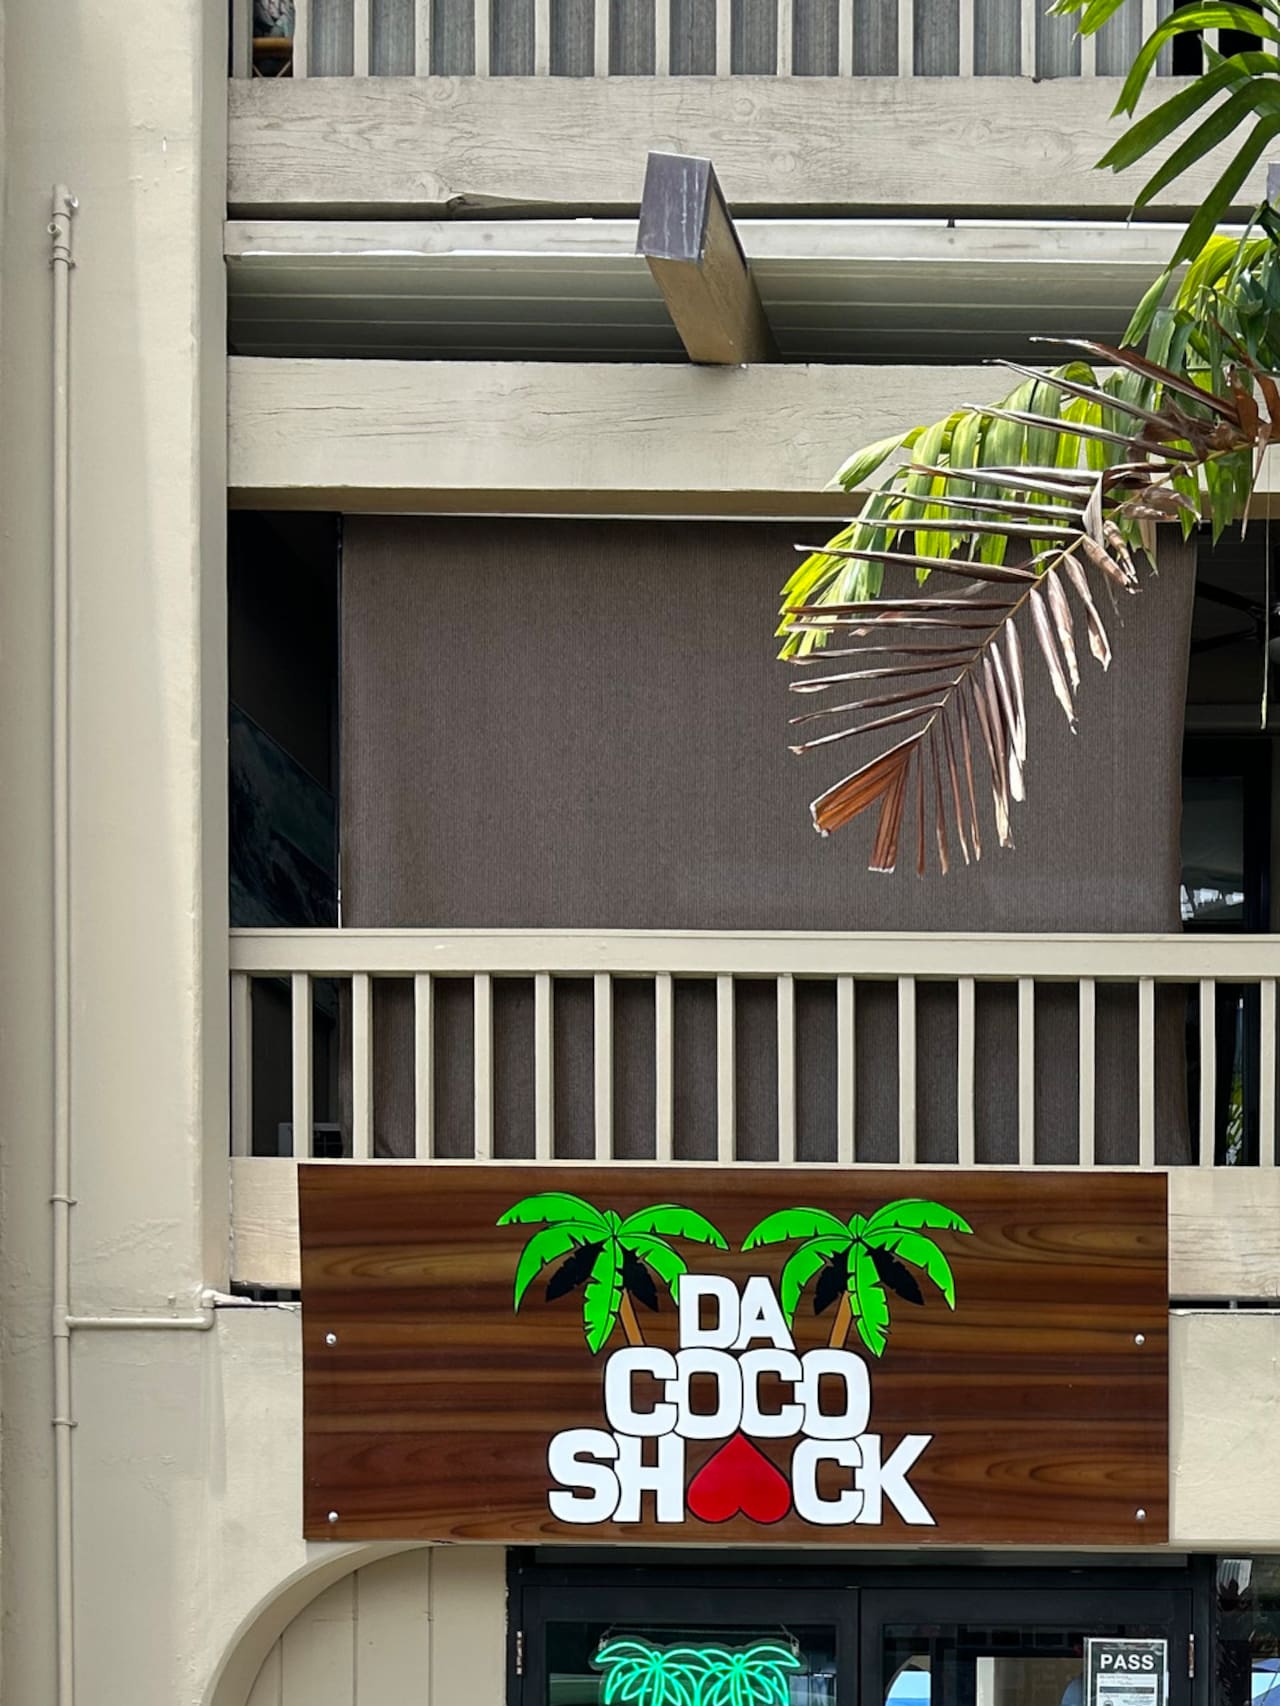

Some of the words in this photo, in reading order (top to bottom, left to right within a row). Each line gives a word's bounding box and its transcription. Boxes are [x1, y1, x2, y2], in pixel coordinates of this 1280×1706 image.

[678, 1275, 795, 1350] DA
[605, 1347, 871, 1438] COCO
[1100, 1653, 1154, 1670] PASS
